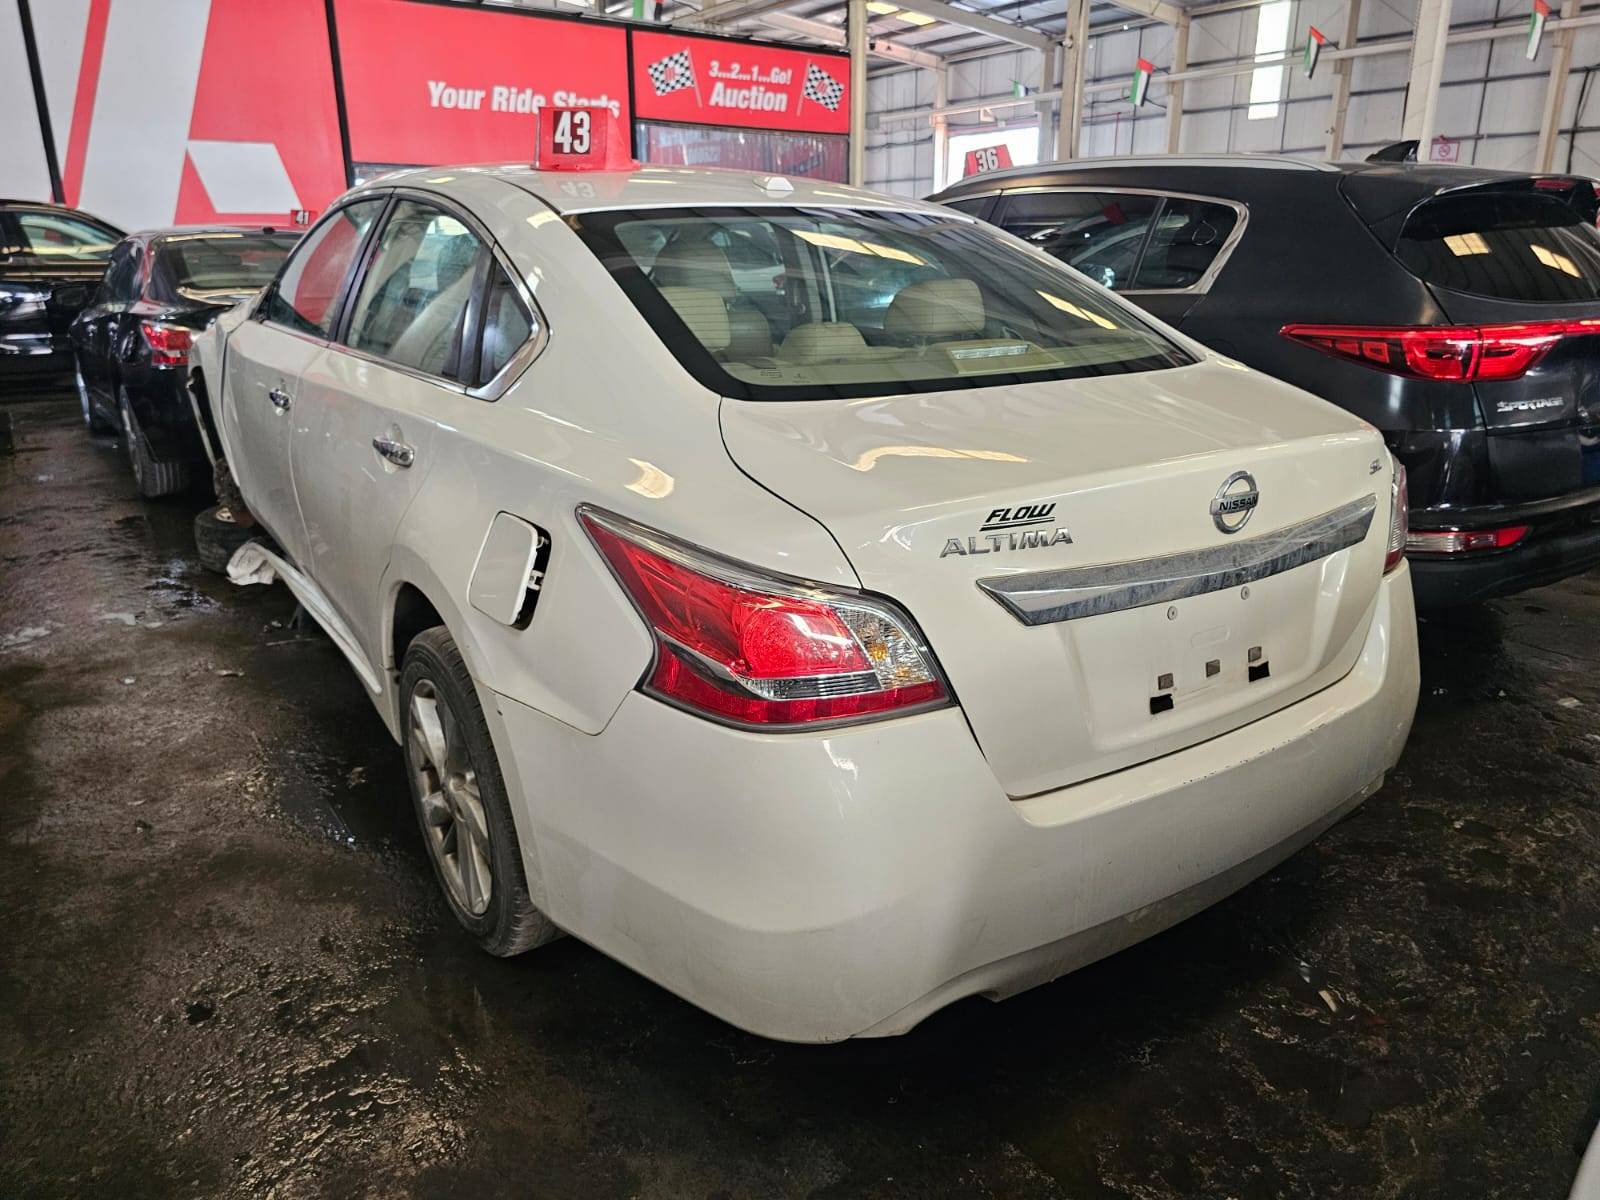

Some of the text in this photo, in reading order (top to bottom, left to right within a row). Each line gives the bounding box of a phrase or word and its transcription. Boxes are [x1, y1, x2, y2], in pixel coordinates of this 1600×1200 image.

[708, 60, 793, 85] 3...2...1...Go!
[427, 80, 486, 110] Your
[491, 85, 546, 115] Ride
[709, 81, 788, 112] Auction
[554, 110, 590, 154] 43
[975, 148, 999, 173] 36
[296, 210, 309, 225] 41
[984, 502, 1057, 524] FLOW
[1219, 496, 1257, 511] NISSAN
[939, 527, 1073, 559] ALTIMA
